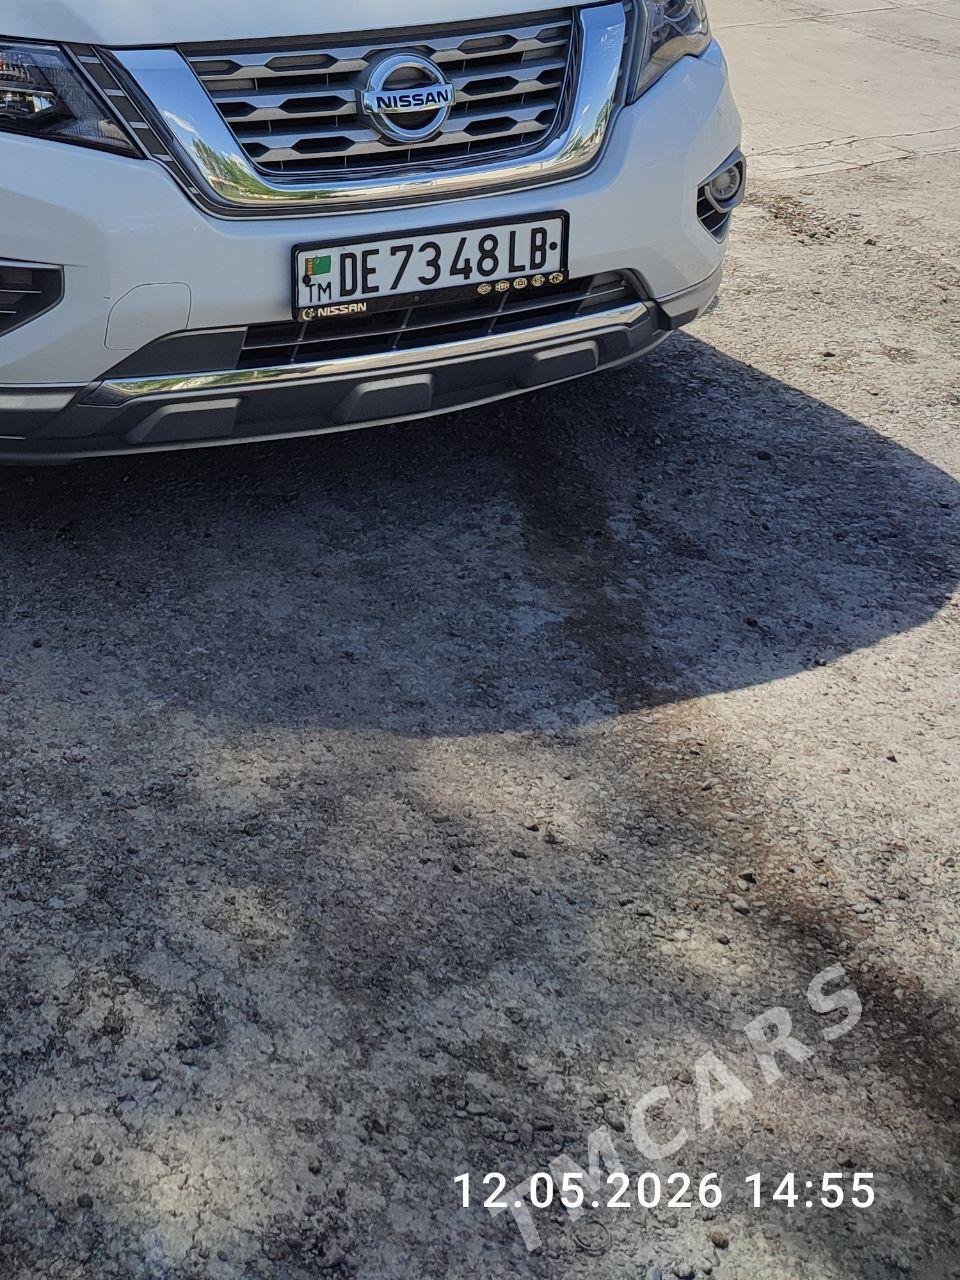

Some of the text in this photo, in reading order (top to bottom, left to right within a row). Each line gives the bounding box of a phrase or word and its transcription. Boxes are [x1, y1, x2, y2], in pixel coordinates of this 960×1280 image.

[376, 89, 449, 109] NISSAN
[307, 282, 332, 303] TM
[317, 302, 367, 317] NISSAN
